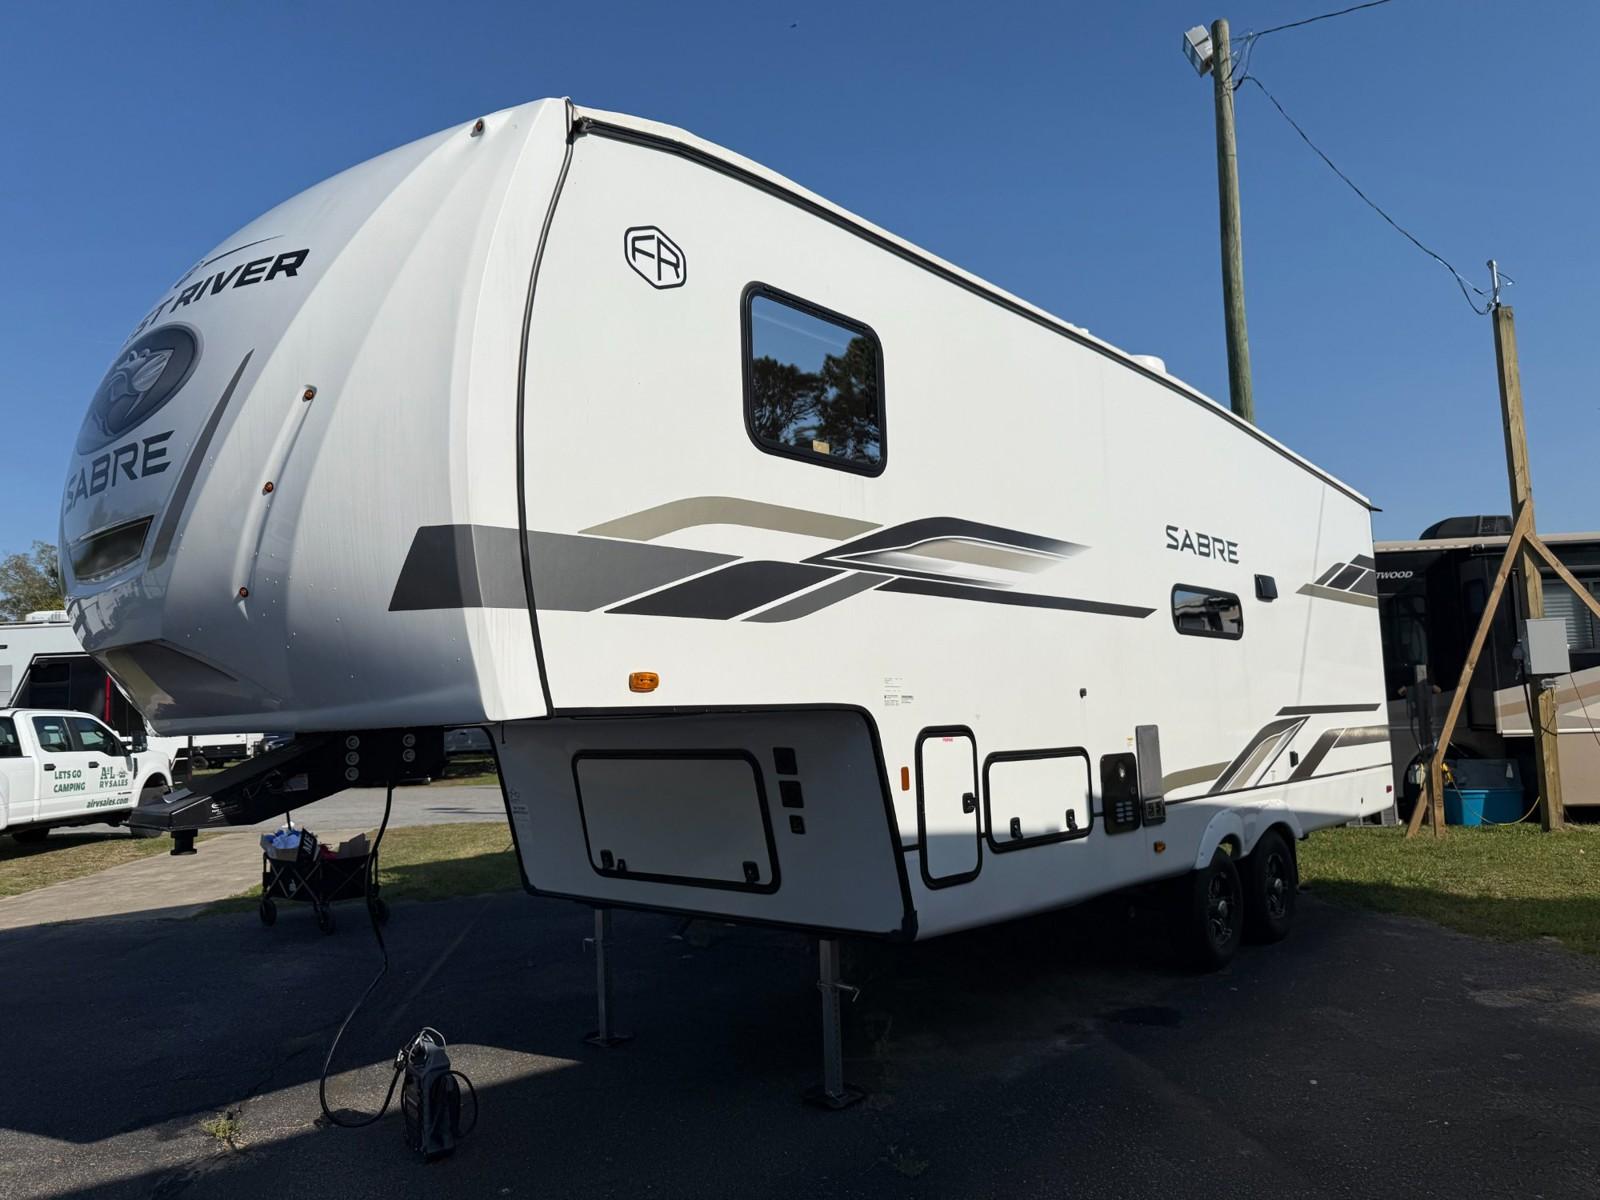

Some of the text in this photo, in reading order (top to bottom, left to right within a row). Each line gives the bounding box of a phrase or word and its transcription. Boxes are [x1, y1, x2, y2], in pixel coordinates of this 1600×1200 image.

[169, 248, 310, 313] RIVER
[65, 430, 175, 515] SABRE
[1165, 524, 1240, 565] SABRE
[1376, 570, 1413, 579] TWOOD
[53, 782, 86, 793] CAMPING
[54, 769, 82, 780] LETS GO
